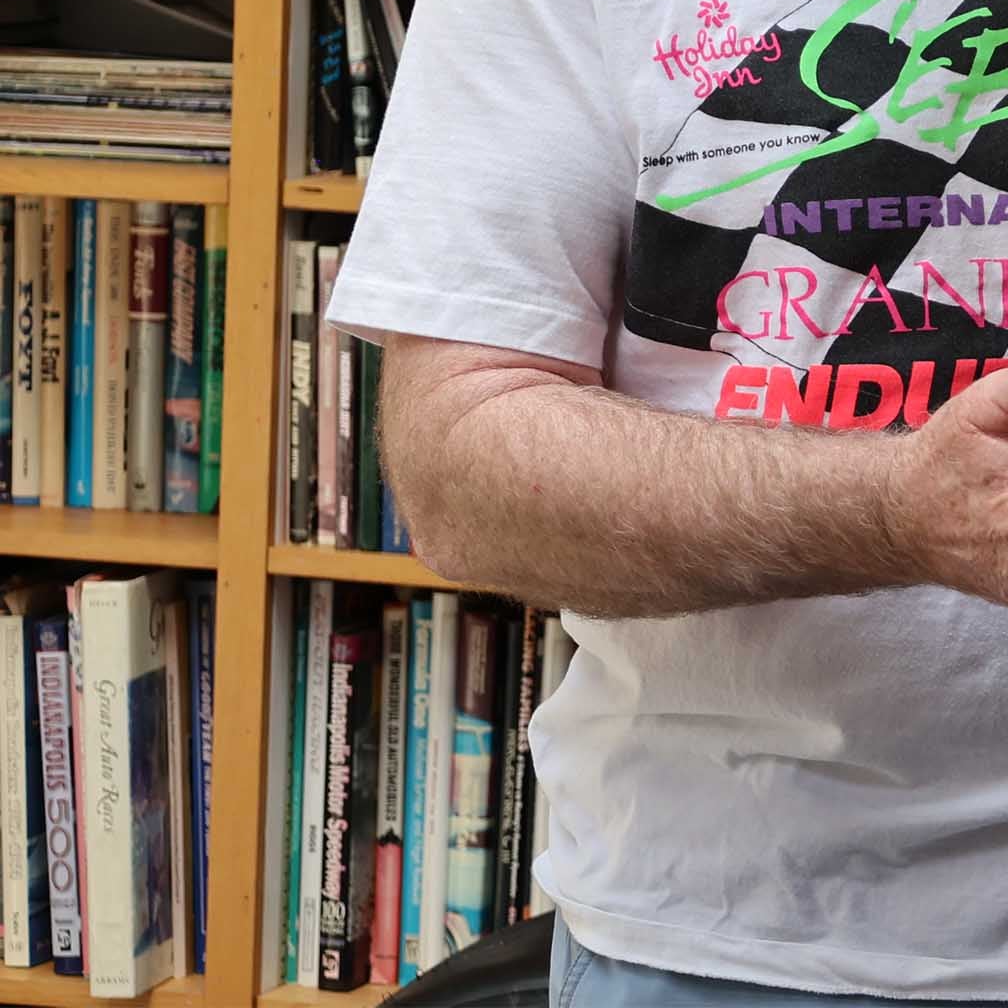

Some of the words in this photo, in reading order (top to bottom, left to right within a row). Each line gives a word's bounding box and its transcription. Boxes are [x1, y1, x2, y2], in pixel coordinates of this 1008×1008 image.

[652, 25, 782, 81] Holiday
[694, 65, 763, 100] Inn
[642, 154, 674, 168] Sleep
[676, 149, 699, 164] with
[702, 142, 756, 160] someone
[759, 137, 783, 152] you
[786, 132, 821, 145] know
[18, 279, 34, 392] FOYT
[292, 340, 311, 407] INDY
[40, 656, 67, 791] INDIANAPOLIS
[93, 679, 118, 728] Great
[326, 663, 353, 764] Indianapolis
[99, 730, 119, 780] Auto
[95, 785, 120, 834] Races
[327, 765, 350, 816] Motor
[47, 798, 75, 892] 500
[320, 818, 349, 900] Speedway
